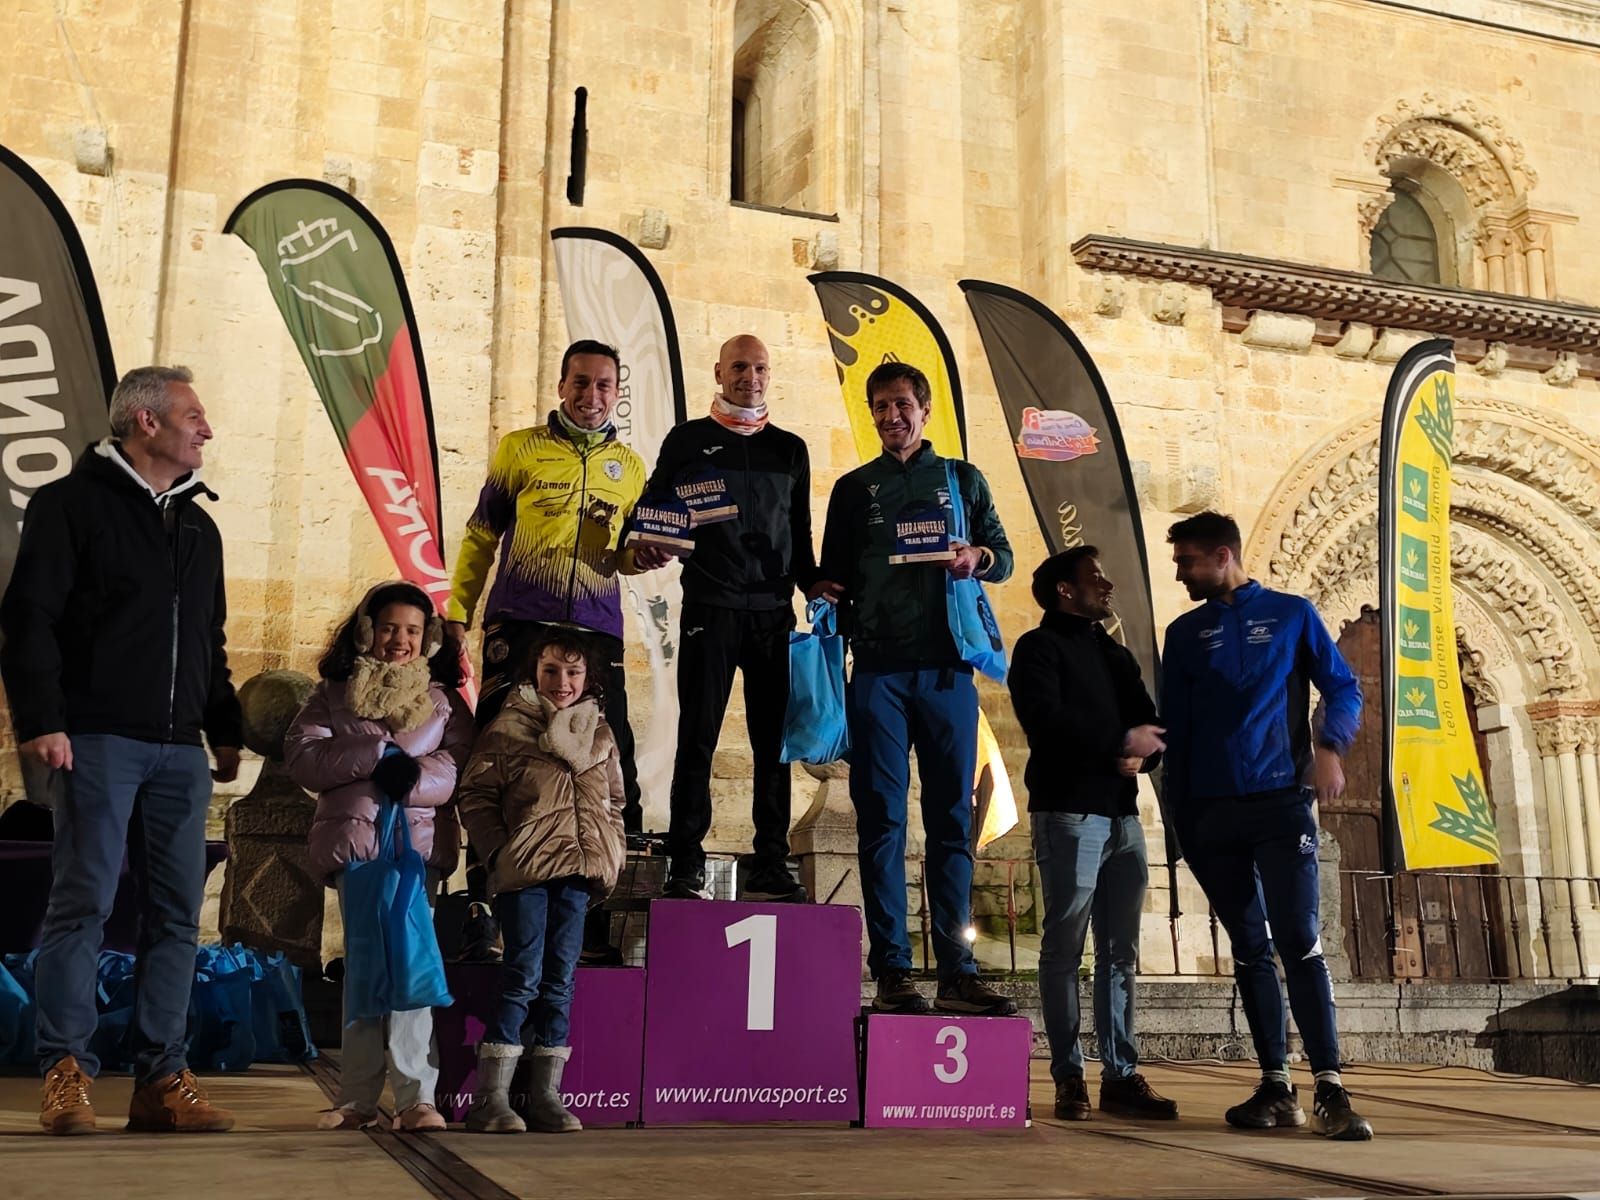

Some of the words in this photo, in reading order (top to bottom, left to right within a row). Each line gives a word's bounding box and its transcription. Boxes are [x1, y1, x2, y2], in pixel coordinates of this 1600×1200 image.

[675, 479, 727, 499] BARRANQUERAS
[685, 499, 703, 507] TRAIL
[704, 495, 721, 503] NIGHT
[1431, 465, 1441, 525] Zamora
[636, 506, 688, 528] BARRANQUERAS
[643, 523, 661, 531] TRAIL
[661, 525, 680, 534] NIGHT
[896, 520, 946, 538] BARRANQUERAS
[904, 537, 921, 545] TRAIL
[922, 536, 940, 544] NIGHT
[1431, 534, 1443, 614] Valladolid
[1435, 625, 1449, 690] Ourense
[1443, 700, 1457, 737] León
[724, 914, 777, 1031] 1
[933, 1026, 969, 1084] 3
[655, 1085, 848, 1109] www.runvasport.es
